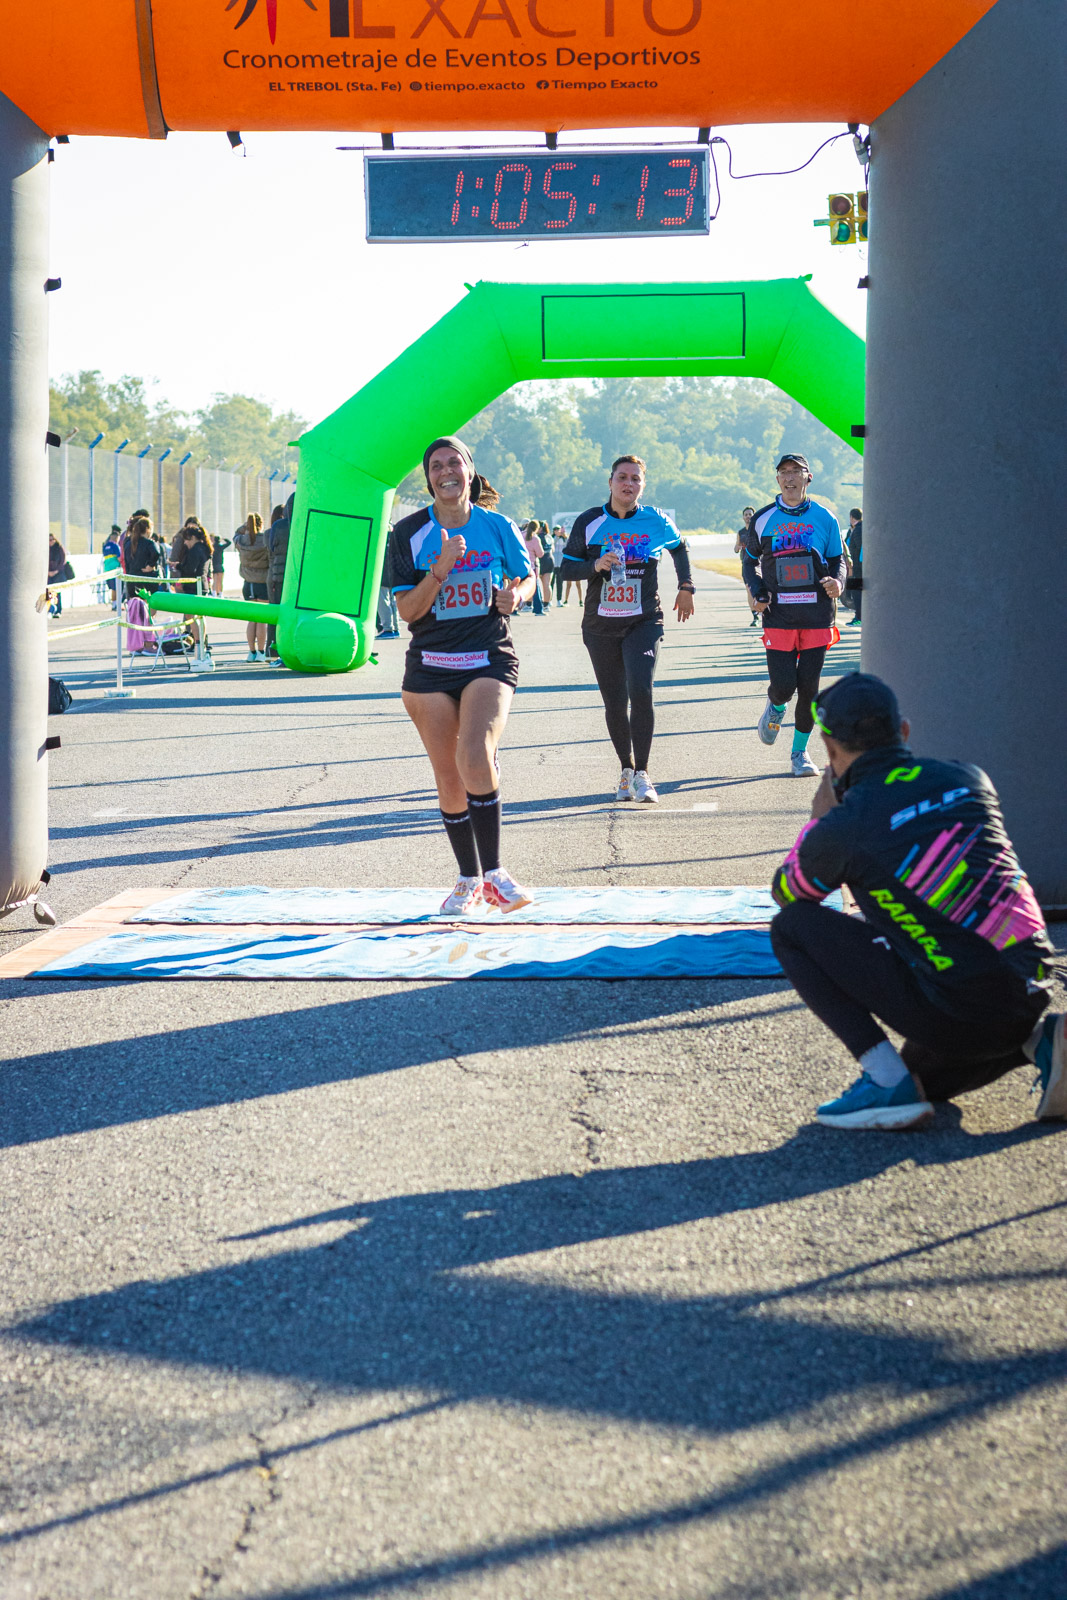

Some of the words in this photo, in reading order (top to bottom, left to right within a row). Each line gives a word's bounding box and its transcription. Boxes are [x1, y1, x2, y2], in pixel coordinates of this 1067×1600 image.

[223, 49, 398, 73] Cronometraje
[405, 48, 437, 68] de
[445, 48, 548, 68] Eventos
[556, 47, 701, 70] Deportivos
[269, 82, 286, 92] EL
[287, 82, 343, 92] TREBOL
[346, 81, 378, 92] (Sta.
[381, 81, 402, 92] Fe)
[424, 80, 526, 92] tiempo.exacto
[552, 79, 607, 91] Tiempo
[610, 79, 658, 90] Exacto
[445, 582, 483, 608] 256
[607, 585, 634, 603] 233
[464, 652, 485, 662] Salud
[890, 787, 970, 831] SLP
